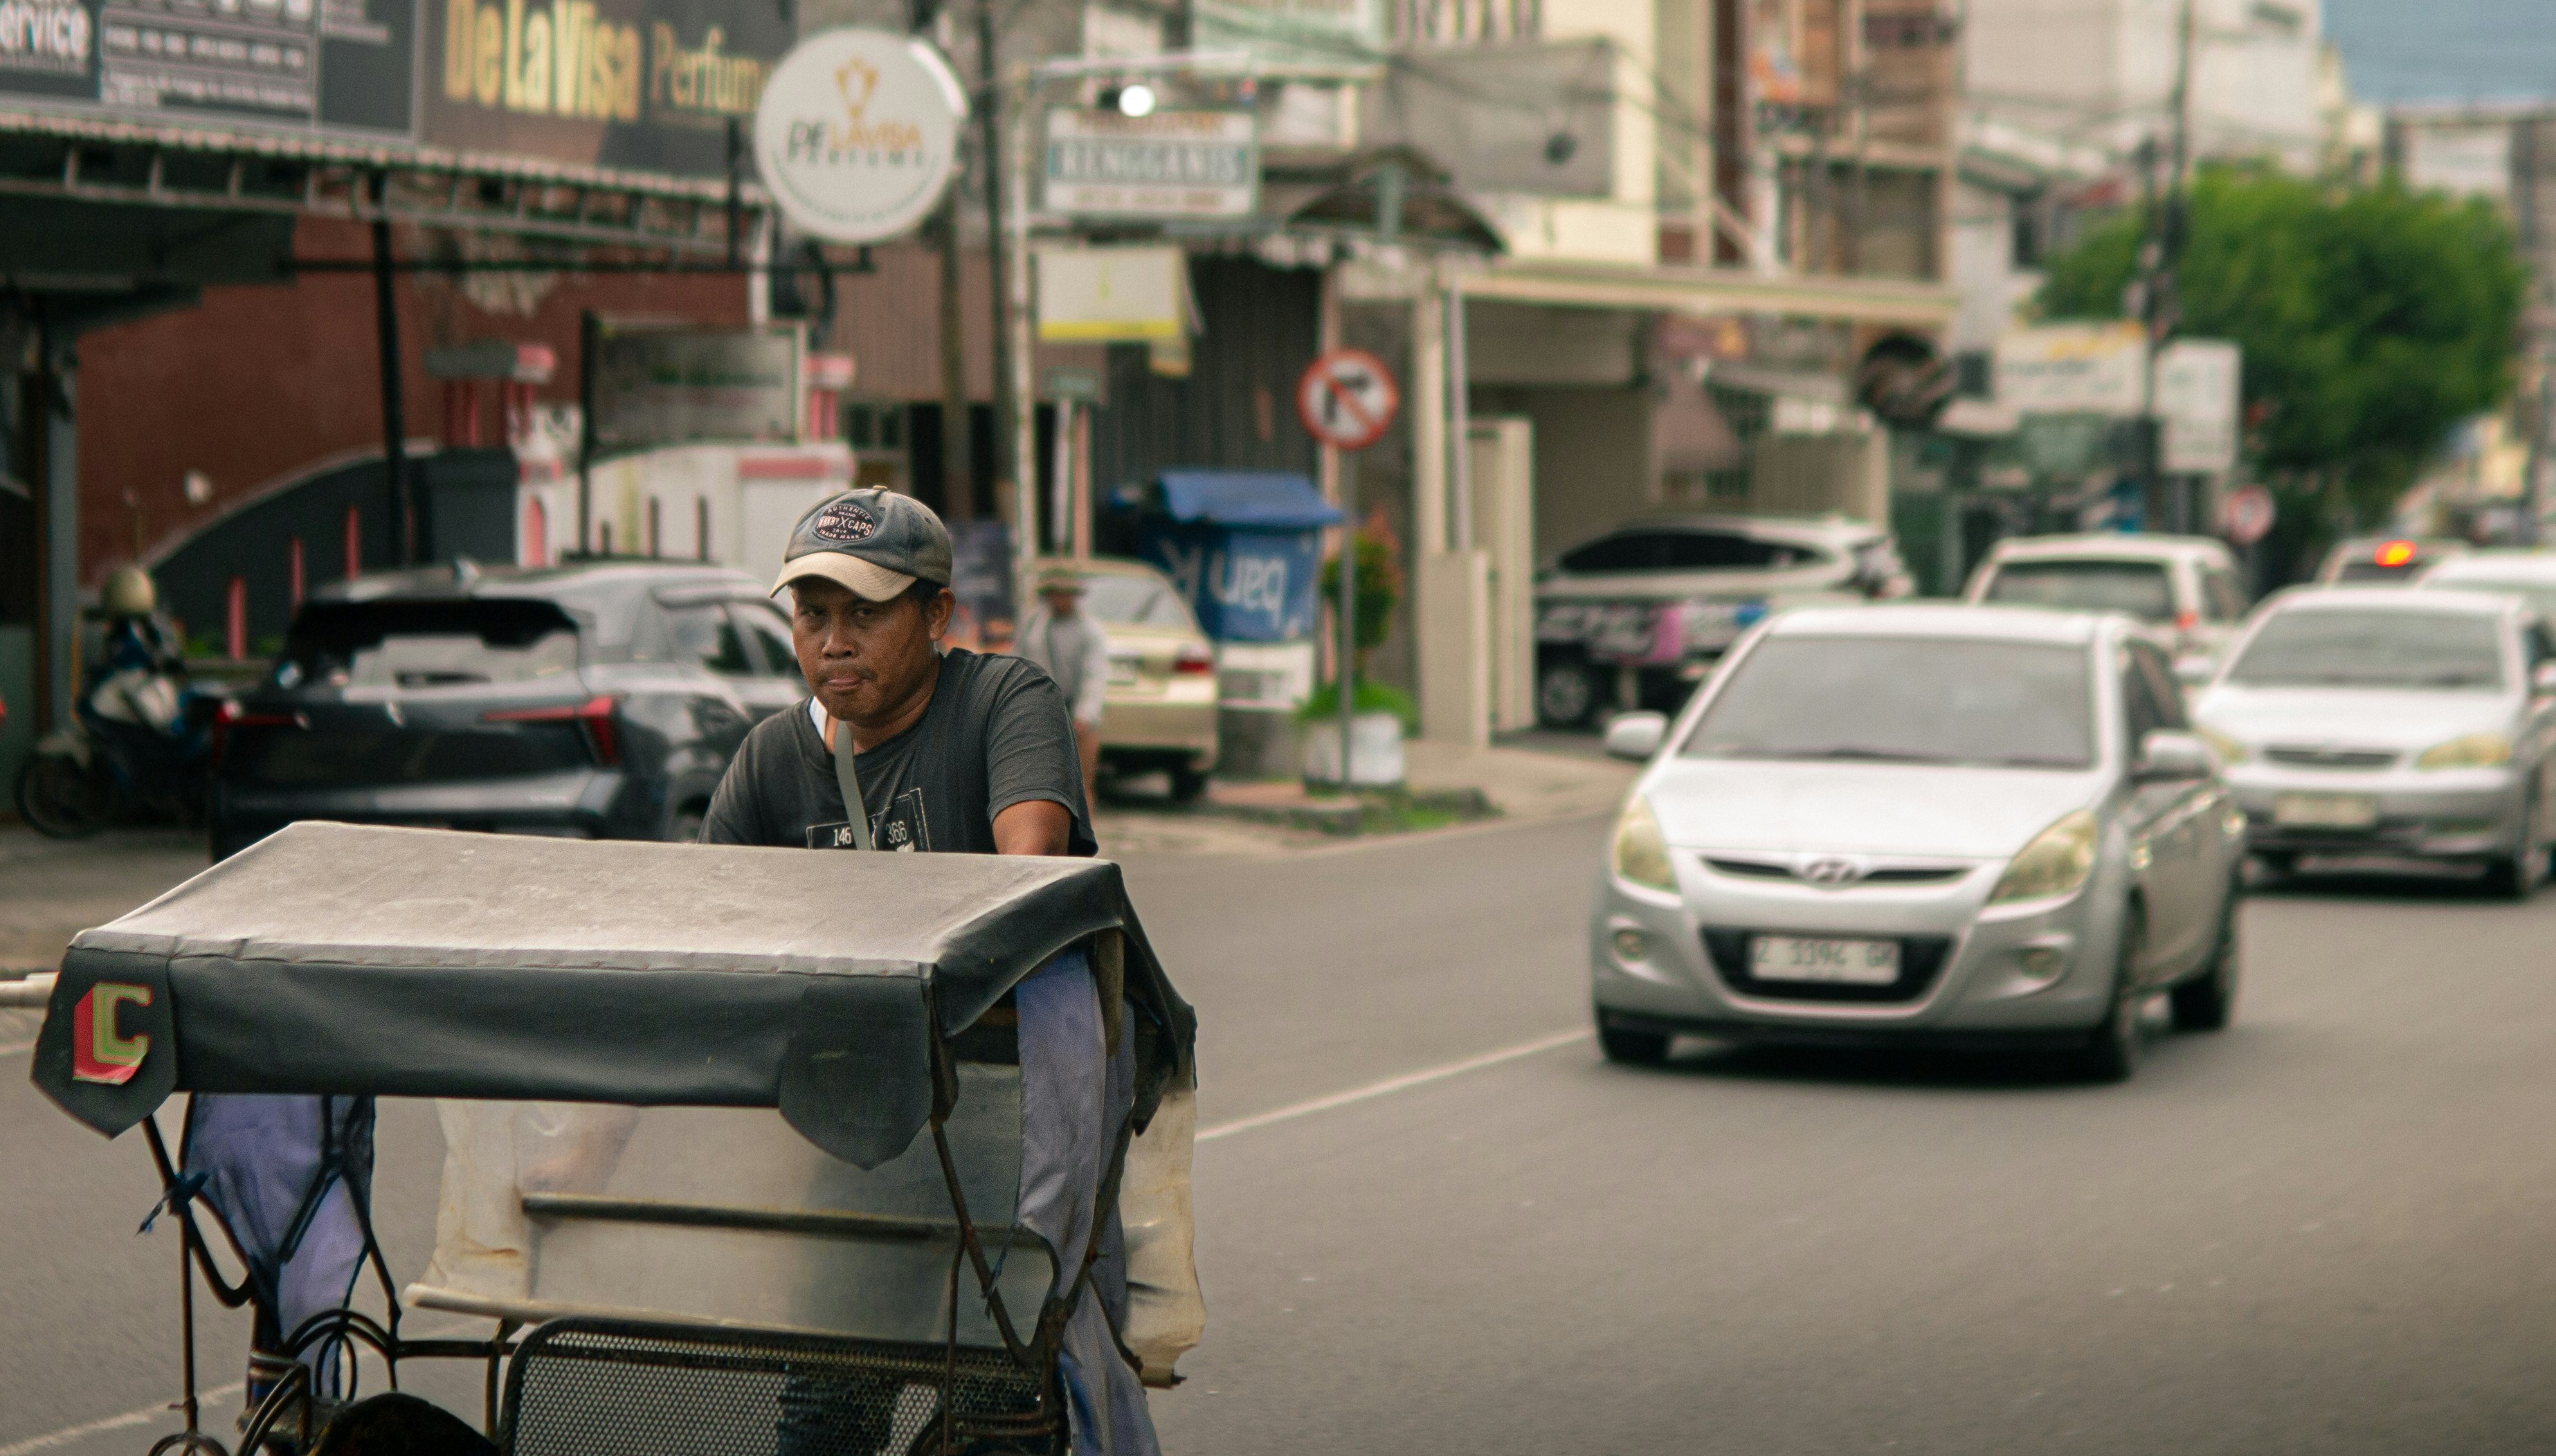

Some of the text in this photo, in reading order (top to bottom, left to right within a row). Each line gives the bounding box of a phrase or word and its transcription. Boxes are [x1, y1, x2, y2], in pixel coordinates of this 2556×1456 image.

[649, 22, 774, 115] Perfum
[827, 506, 870, 520] AUTHENTIC
[819, 529, 837, 538] TRADE
[847, 520, 873, 536] CAPS
[833, 820, 907, 846] 146 366
